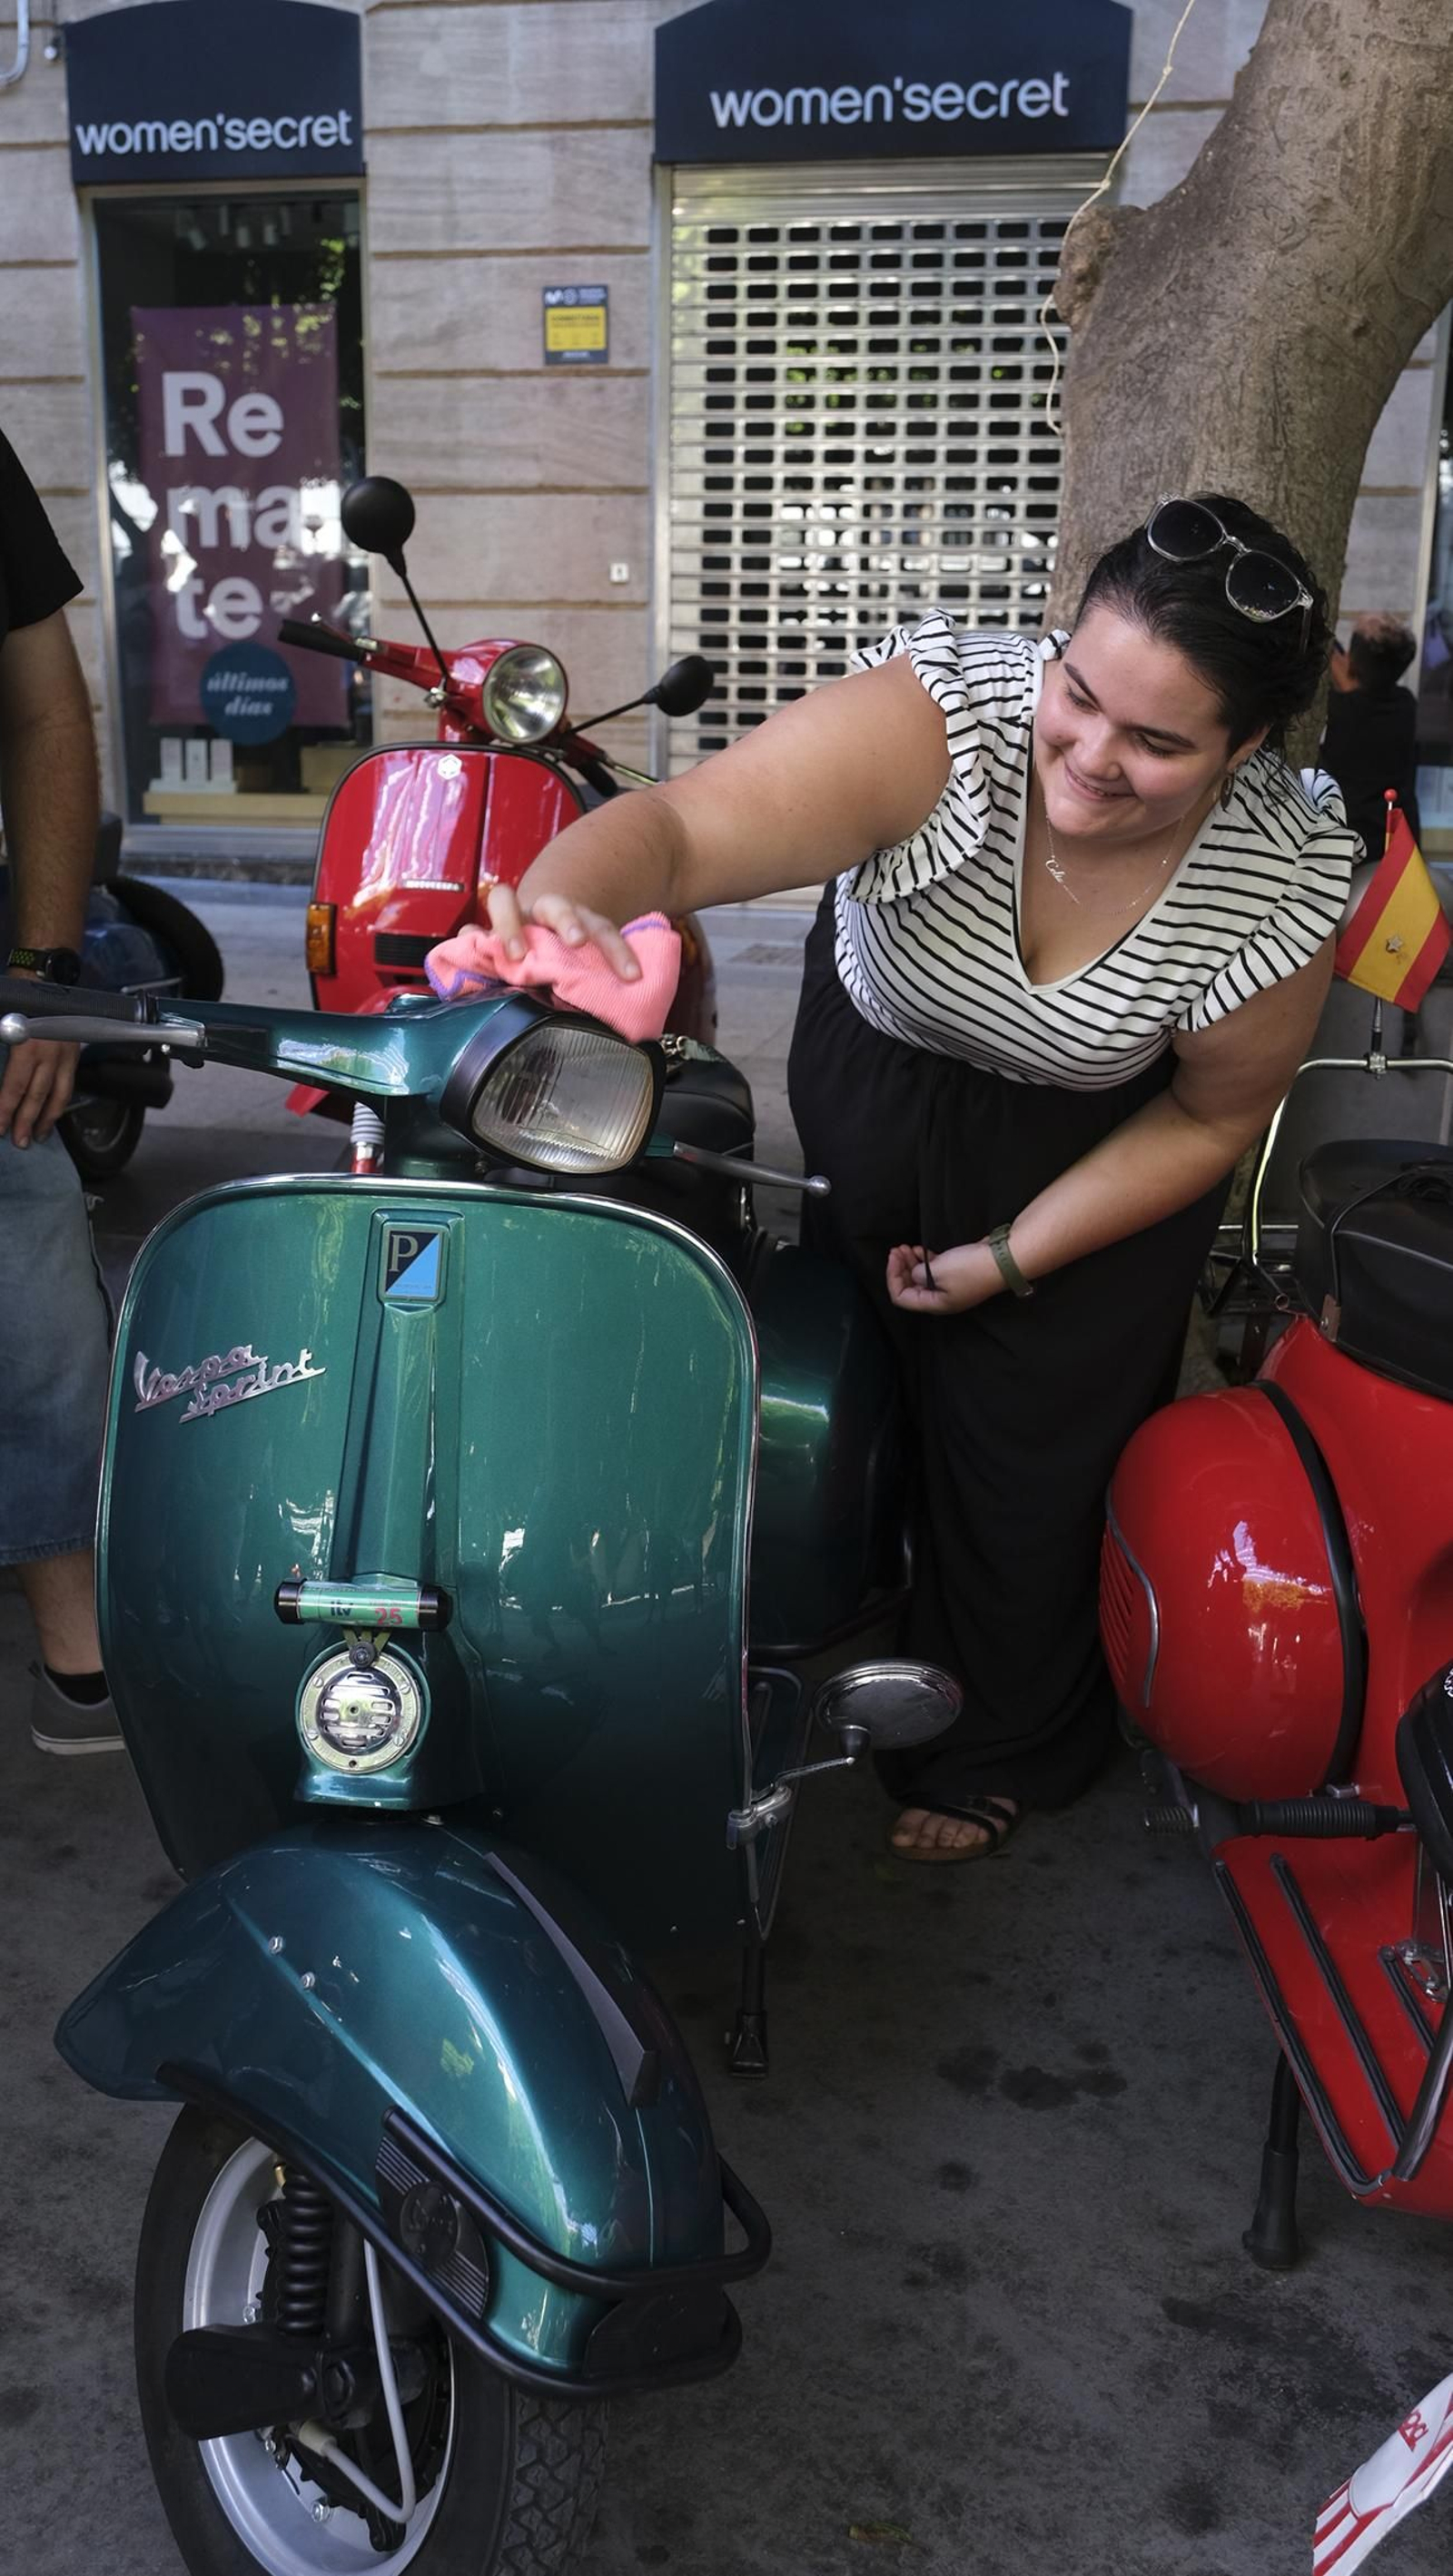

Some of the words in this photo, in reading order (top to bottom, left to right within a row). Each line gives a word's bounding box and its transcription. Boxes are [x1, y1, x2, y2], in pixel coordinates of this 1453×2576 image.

[710, 71, 1071, 128] women'secret
[74, 109, 353, 155] women'secret
[163, 370, 284, 457] Re
[167, 485, 305, 549] ma
[173, 561, 263, 639] te
[207, 671, 290, 692] últimos
[224, 696, 273, 716] días
[388, 1233, 419, 1272] P
[134, 1343, 269, 1413] Vespa
[179, 1347, 326, 1424] Sprint
[374, 1606, 403, 1626] 25
